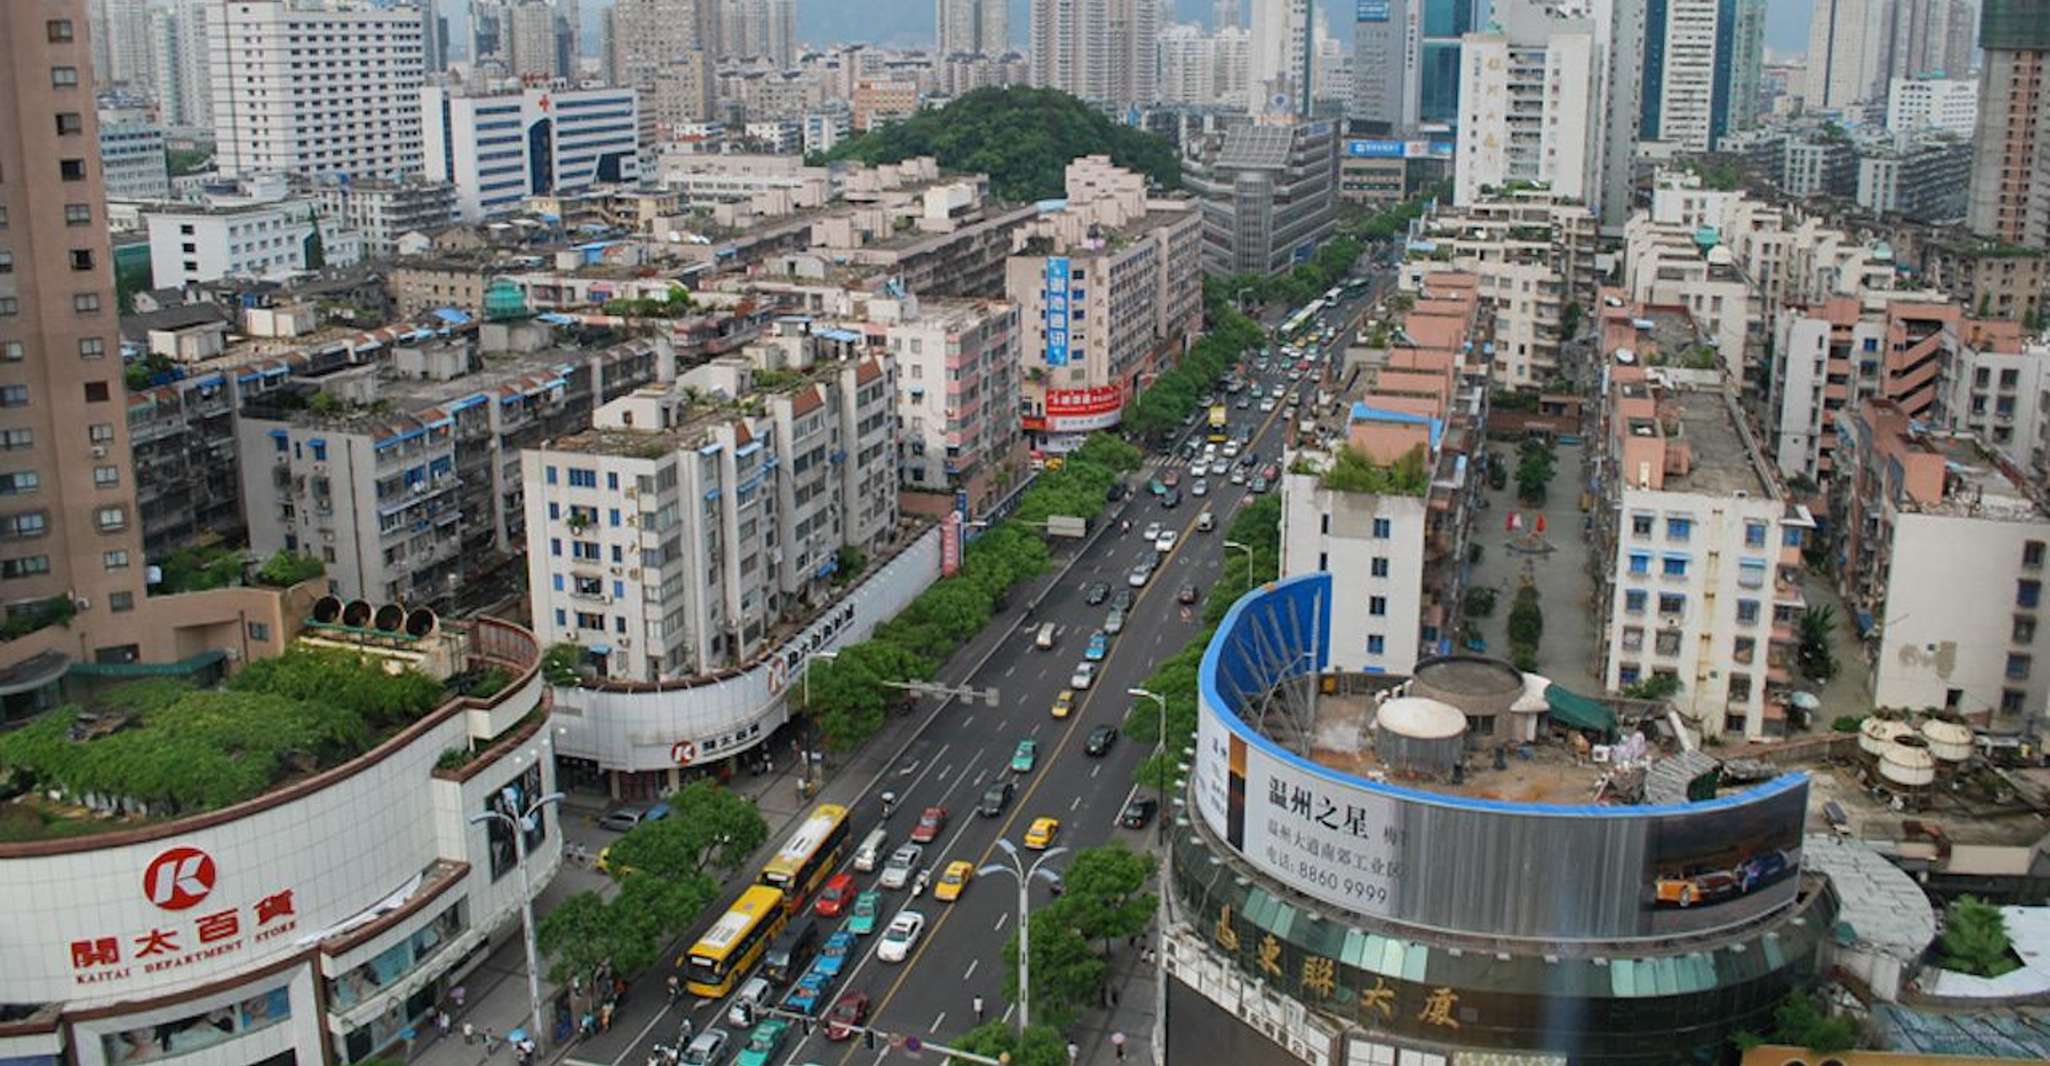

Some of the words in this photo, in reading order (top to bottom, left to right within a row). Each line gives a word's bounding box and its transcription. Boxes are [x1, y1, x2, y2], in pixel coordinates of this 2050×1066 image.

[1267, 774, 1369, 840] 温州之星
[152, 851, 211, 906] K
[1299, 861, 1338, 890] 8860
[1343, 878, 1387, 905] 9999
[75, 967, 131, 985] KAITAI
[144, 940, 243, 974] DEPARTMENT
[254, 920, 297, 944] STORE
